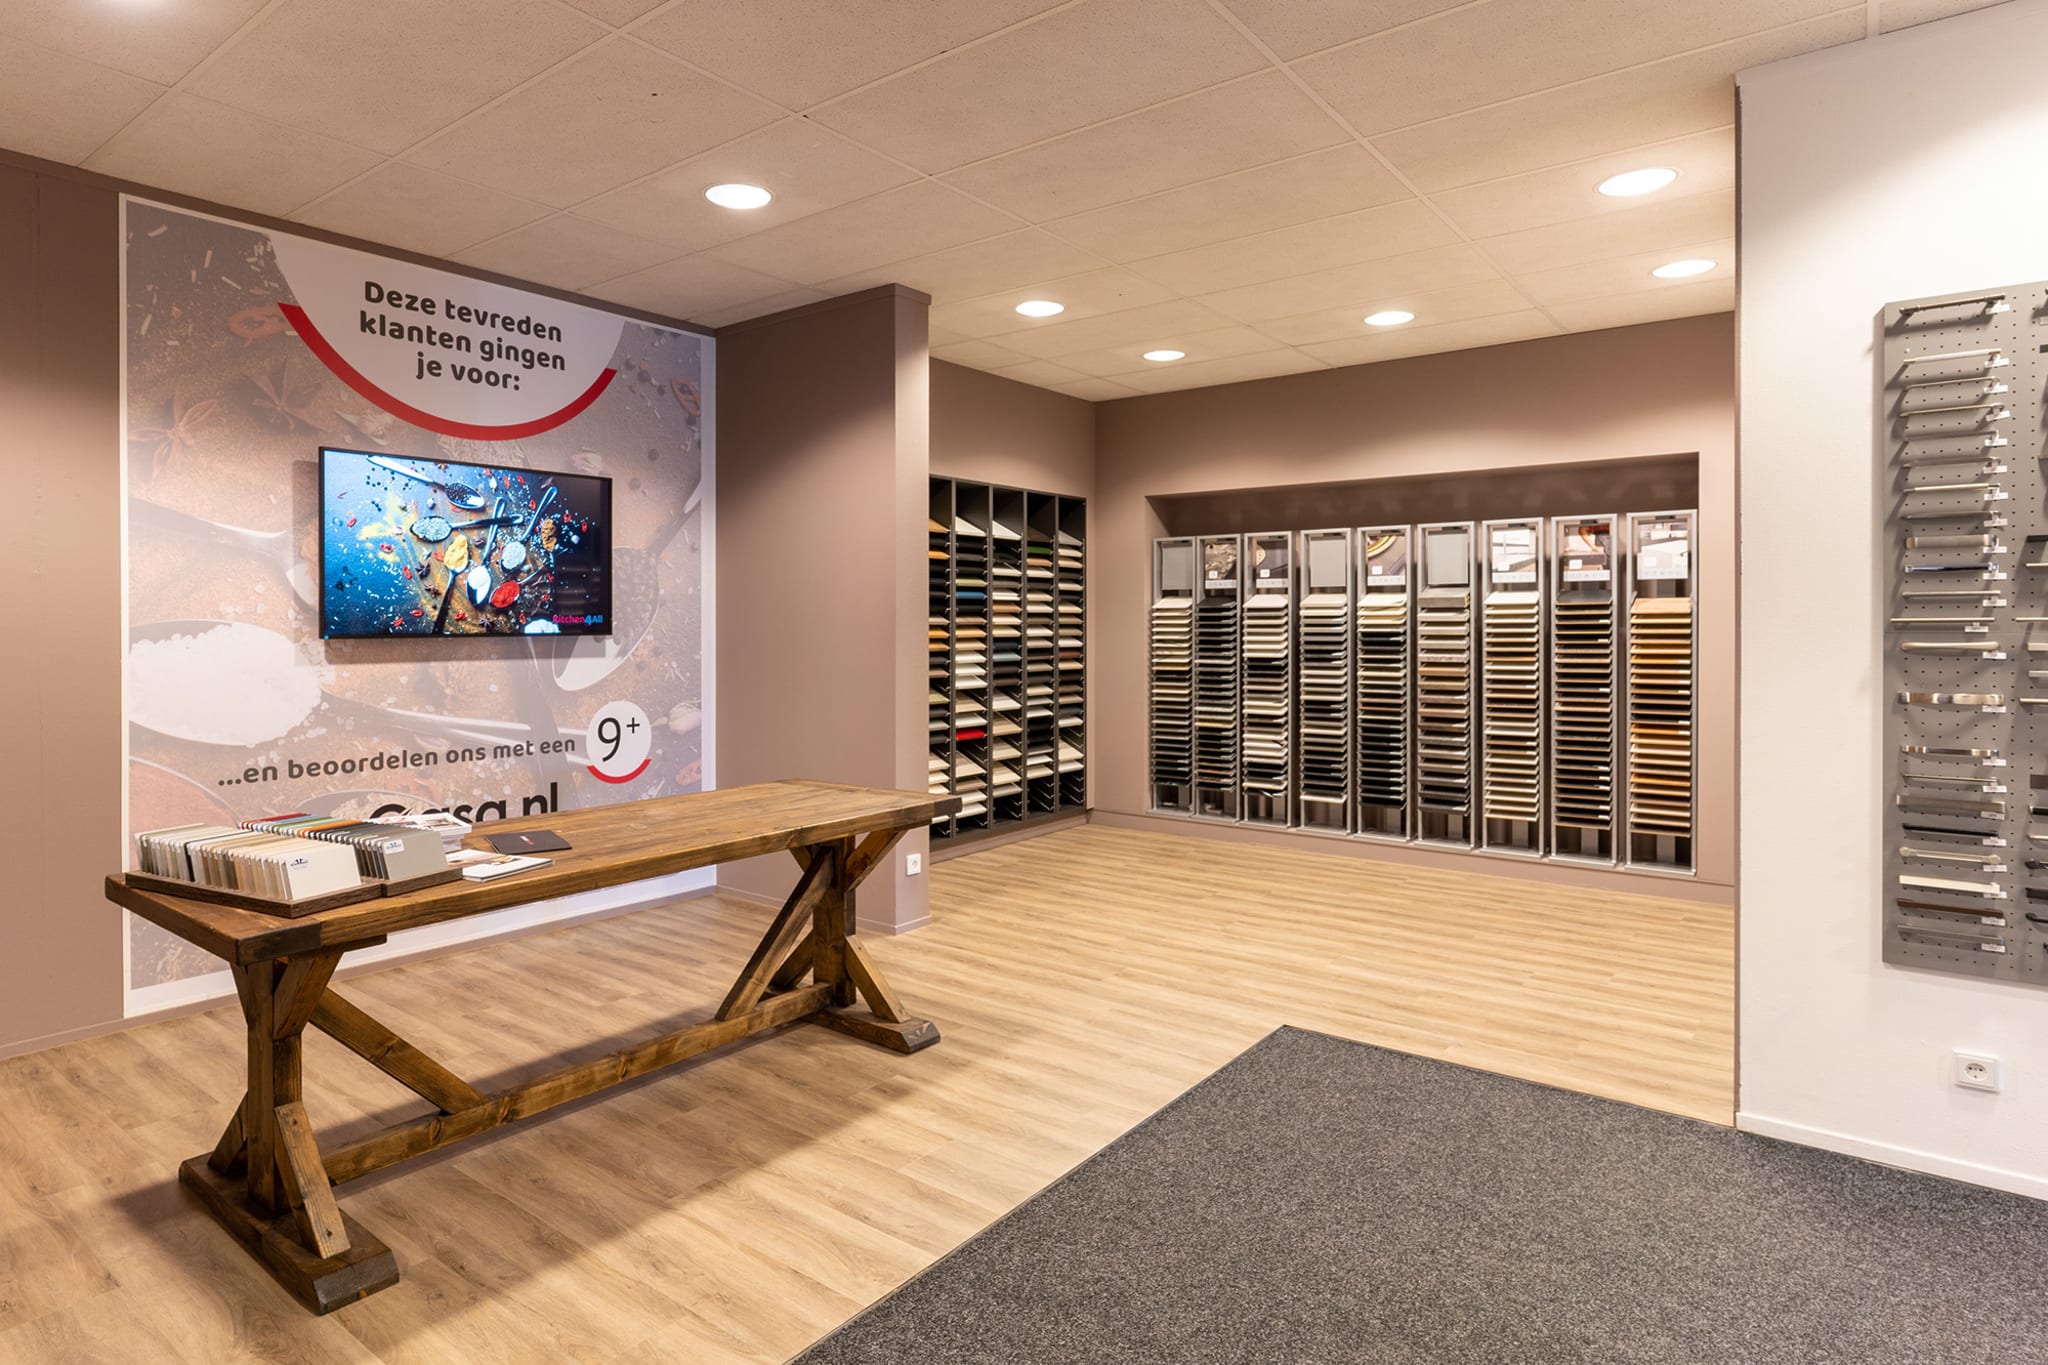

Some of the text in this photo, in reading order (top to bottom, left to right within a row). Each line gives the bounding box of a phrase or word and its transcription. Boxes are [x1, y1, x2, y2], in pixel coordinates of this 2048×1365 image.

[365, 281, 562, 343] Deze tevreden
[360, 310, 566, 371] klanten gingen
[416, 351, 520, 391] je voor:
[218, 765, 278, 786] ...en
[288, 750, 438, 779] beoordelen
[446, 747, 486, 763] ons
[493, 740, 534, 760] met
[540, 739, 576, 754] een
